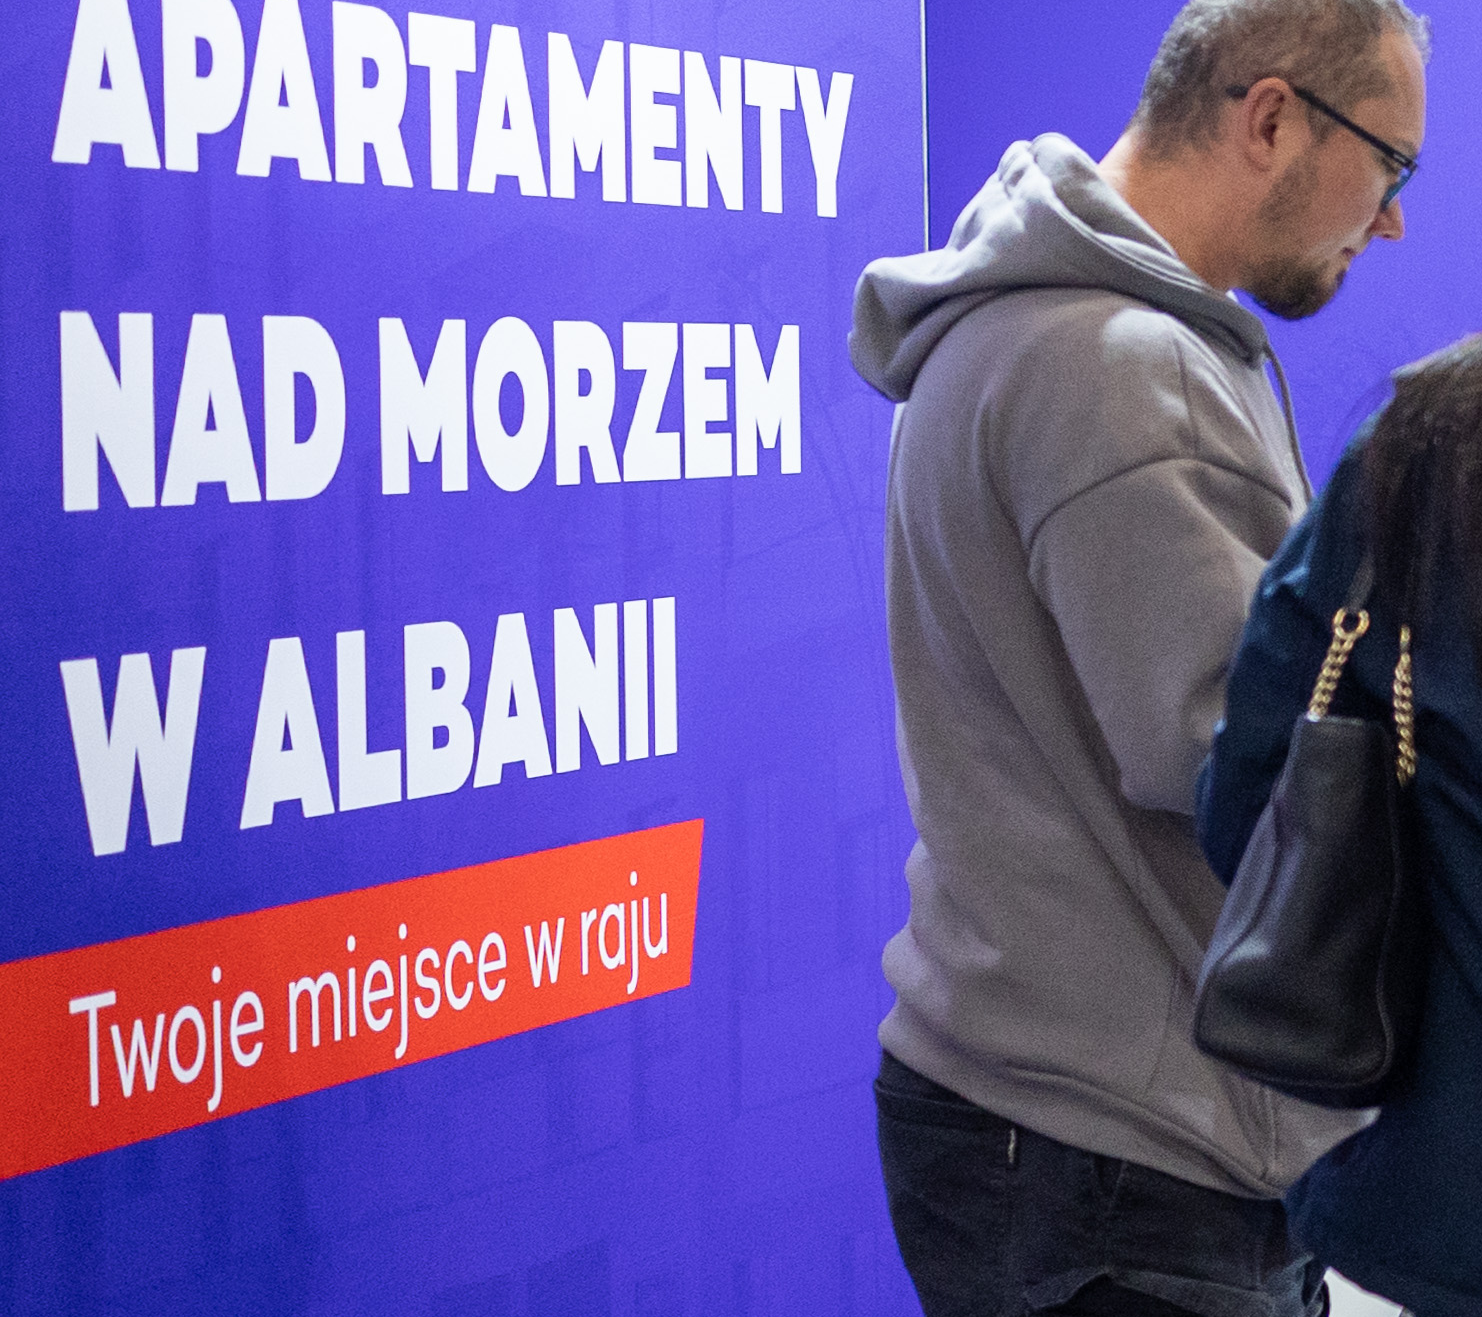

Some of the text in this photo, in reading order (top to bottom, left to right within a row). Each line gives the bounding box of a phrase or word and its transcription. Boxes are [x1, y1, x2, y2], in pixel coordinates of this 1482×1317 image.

[60, 310, 801, 512] NAD MORZEM
[60, 596, 678, 856] W ALBANII
[69, 871, 669, 1113] Twoje miejsce w raju
